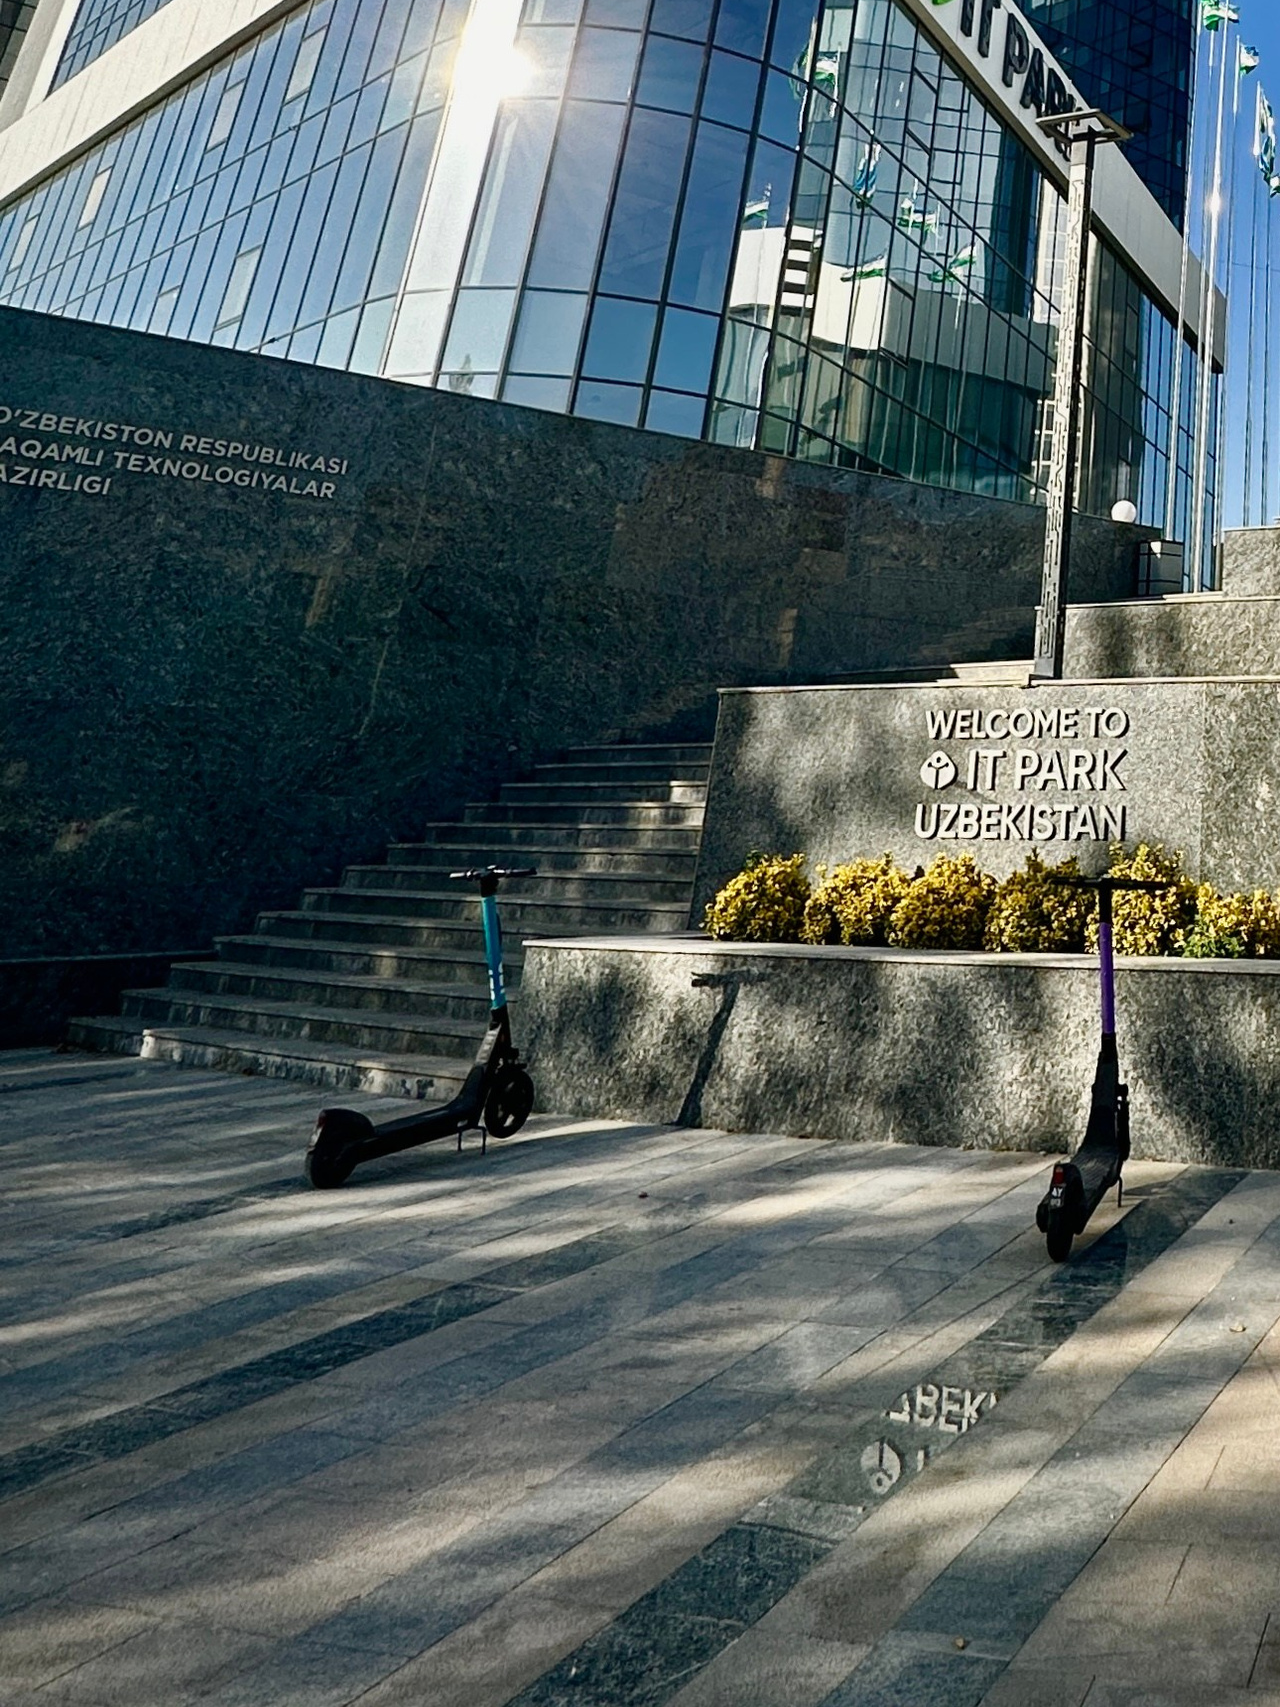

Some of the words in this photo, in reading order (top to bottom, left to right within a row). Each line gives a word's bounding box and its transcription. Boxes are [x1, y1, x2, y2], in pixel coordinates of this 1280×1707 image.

[113, 451, 336, 499] TEXNOLOGIYALAR
[180, 433, 348, 475] RESPUBLIKASI
[925, 708, 1077, 739] WELCOME
[1087, 706, 1129, 738] TO
[966, 749, 1006, 790] IT
[1014, 748, 1128, 790] PARK
[914, 802, 1126, 841] UZBEKISTAN
